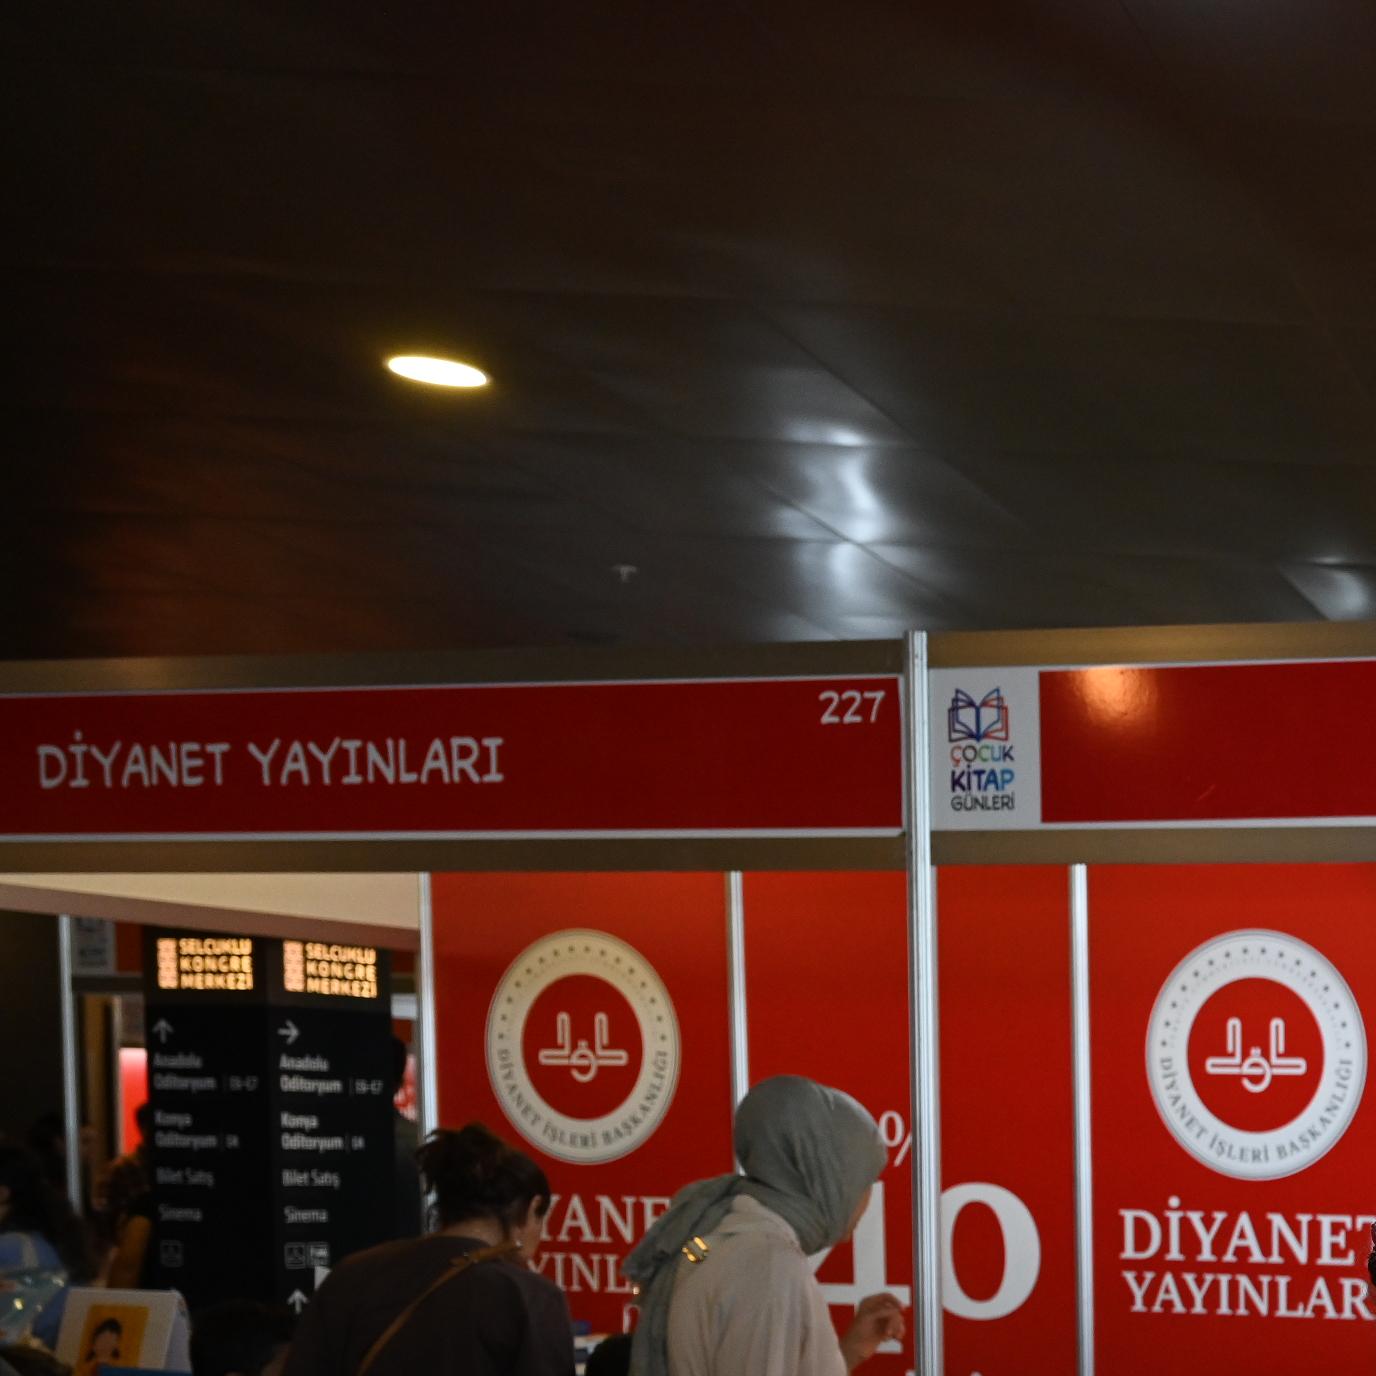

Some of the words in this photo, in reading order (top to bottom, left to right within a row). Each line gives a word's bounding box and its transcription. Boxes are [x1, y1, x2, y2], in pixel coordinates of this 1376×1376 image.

[818, 689, 886, 725] 227
[36, 730, 231, 789] DİYANET
[247, 736, 505, 786] YAYINLARI
[950, 743, 1015, 767] ÇOCUK
[950, 764, 1015, 792] KİTAP
[950, 791, 1015, 812] GÜNLERİ
[1160, 1056, 1209, 1140] DİYANET
[1209, 1134, 1270, 1164] İŞLERİ
[1277, 1058, 1354, 1160] BAŞKANLIĞI
